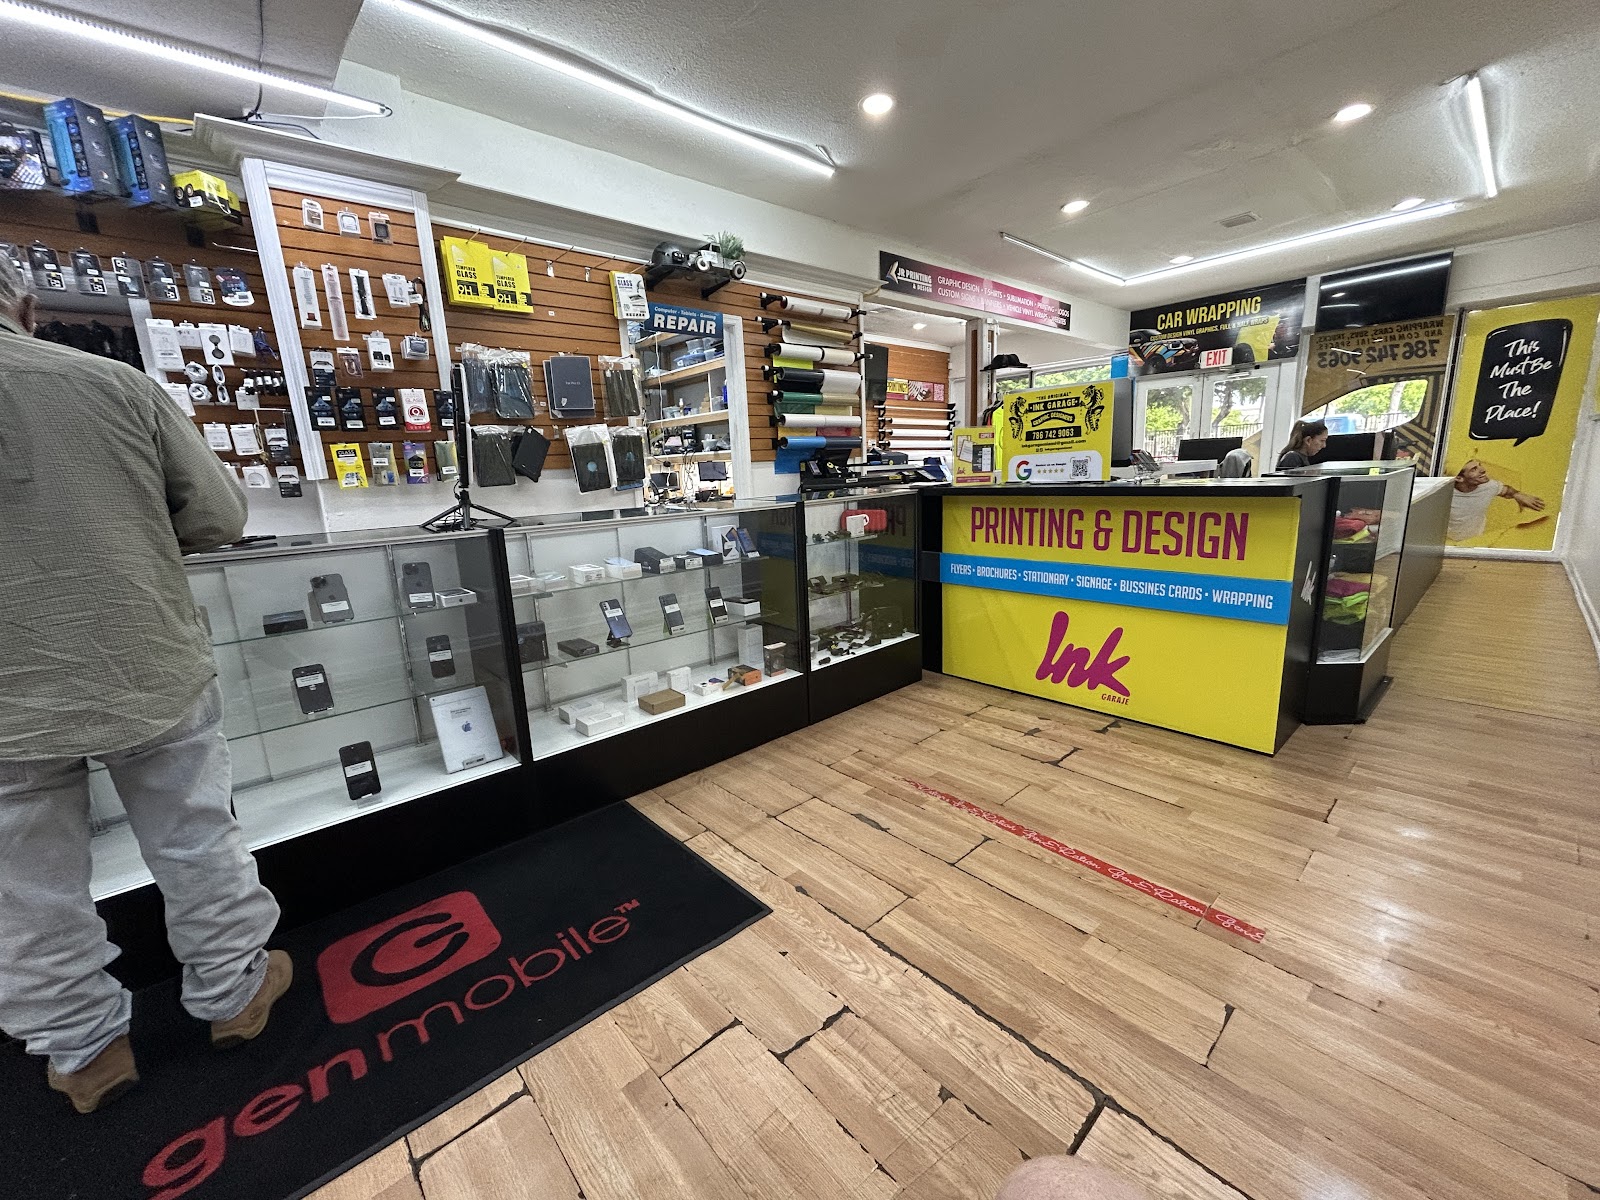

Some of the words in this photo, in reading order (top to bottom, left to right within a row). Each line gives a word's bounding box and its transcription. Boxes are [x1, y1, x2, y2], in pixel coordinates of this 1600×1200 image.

[456, 270, 477, 279] GLASS
[905, 269, 932, 284] PRINTING
[457, 284, 473, 297] 9H
[496, 279, 516, 289] GLASS
[917, 285, 932, 293] DESIGN
[937, 275, 961, 288] GRAPHIC
[962, 282, 979, 293] DESIGN
[1006, 293, 1034, 307] SUBLIMATION
[497, 293, 512, 305] 9H
[937, 287, 960, 299] CUSTOM
[654, 306, 678, 314] Computer
[1157, 312, 1183, 331] CAR
[1186, 295, 1262, 326] WRAPPING
[653, 313, 717, 335] REPAIR
[1220, 323, 1231, 331] FULL
[1504, 338, 1540, 358] This
[1206, 350, 1228, 367] EXIT
[1489, 356, 1531, 378] Must
[1529, 357, 1553, 375] Be
[1498, 381, 1533, 399] The
[1033, 403, 1044, 411] INK
[1047, 398, 1076, 410] GARAGE
[1484, 400, 1542, 424] Place!
[1032, 431, 1043, 440] 786
[1045, 429, 1056, 439] 742
[1057, 427, 1075, 438] 9063
[970, 506, 1085, 550] PRINTING
[1093, 509, 1114, 551] &
[1121, 509, 1250, 561] DESIGN
[950, 563, 972, 576] FLYERS
[976, 566, 1018, 581] BROCHURES
[1023, 570, 1070, 586] STATIONARY
[1076, 575, 1112, 591] SIGNAGE
[1119, 579, 1166, 597] BUSSINES
[1168, 584, 1203, 601] CARDS
[1212, 588, 1274, 610] WRAPPING
[1035, 610, 1131, 698] Ink
[1101, 692, 1130, 706] GARAJE
